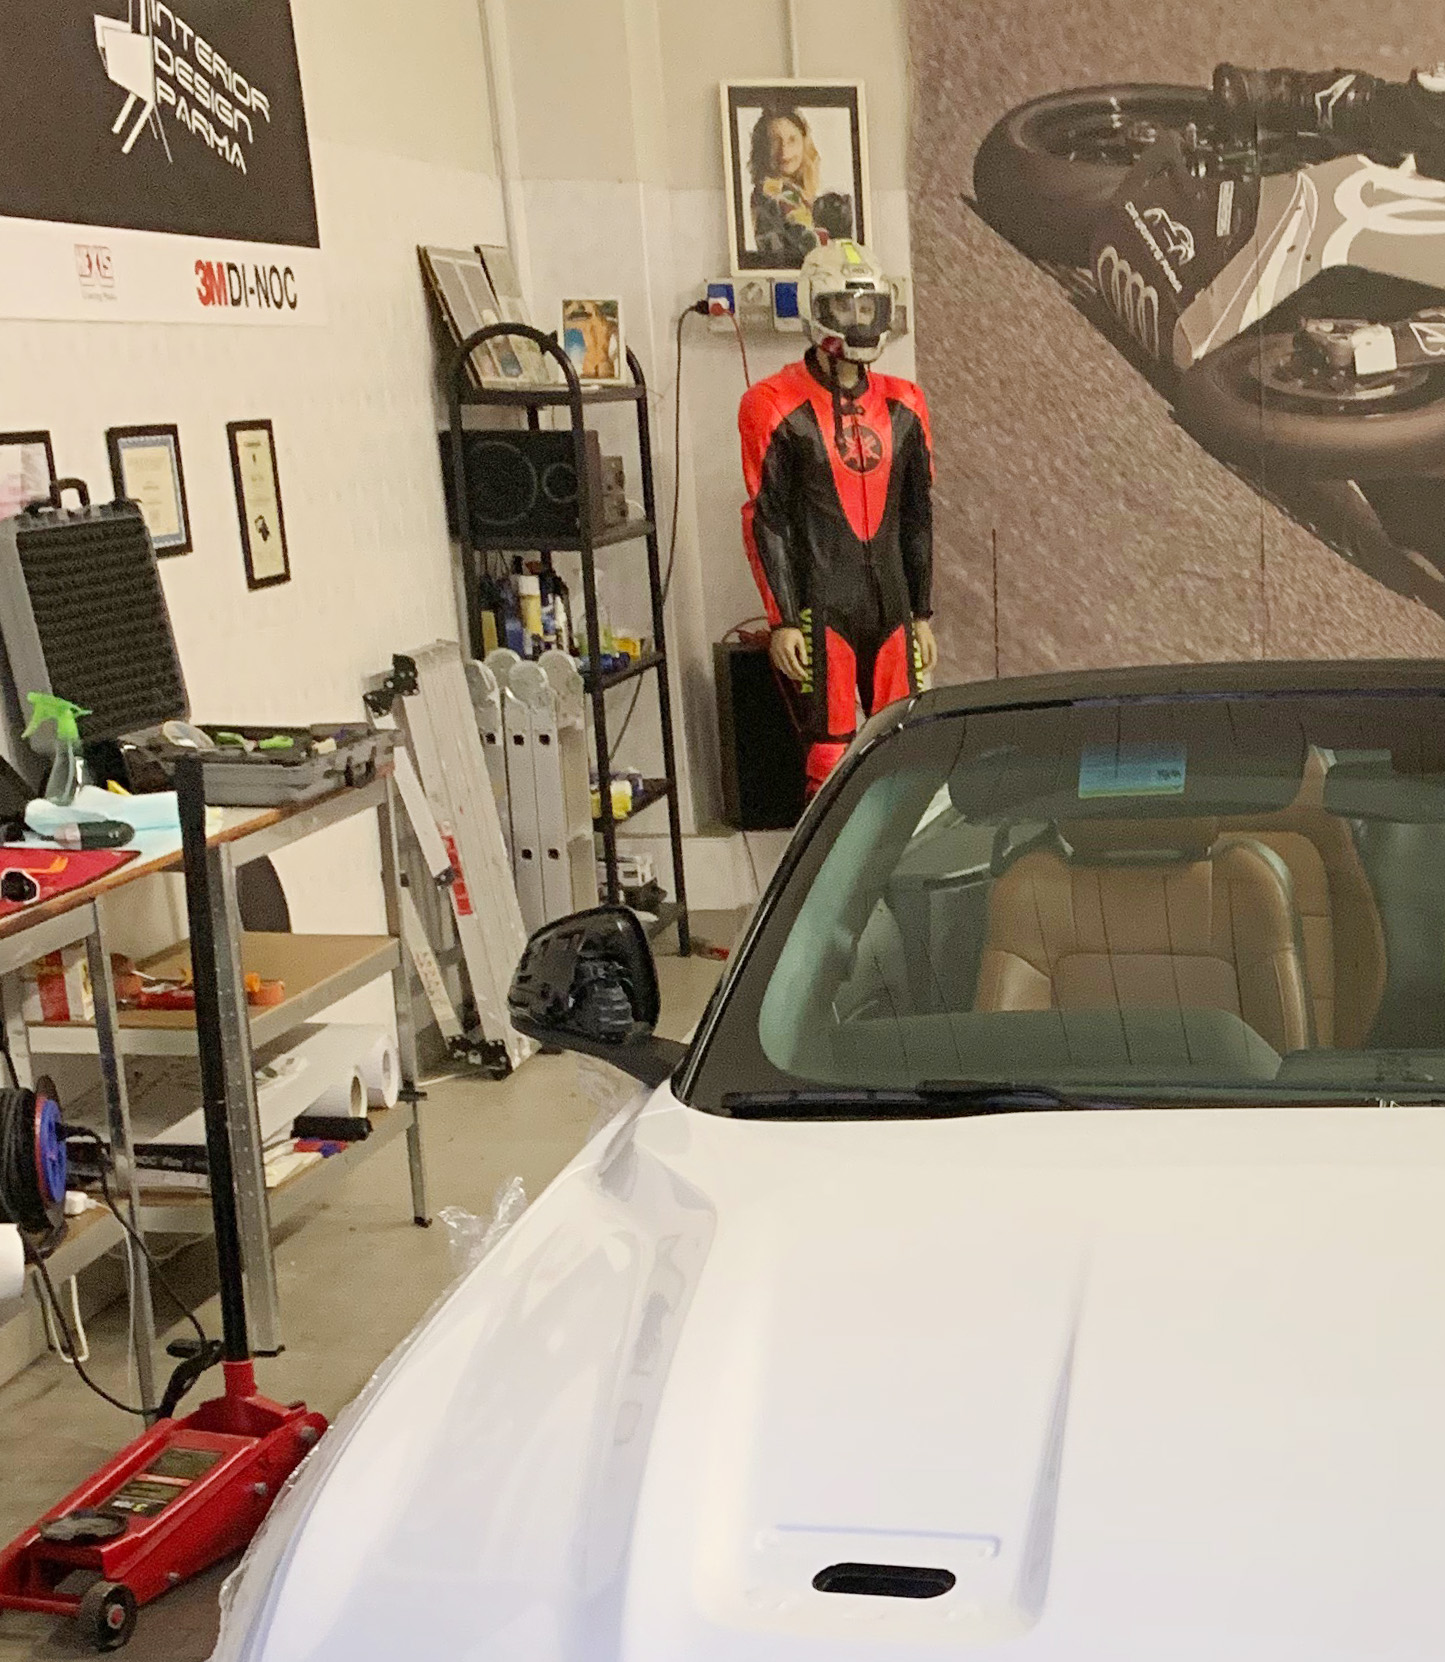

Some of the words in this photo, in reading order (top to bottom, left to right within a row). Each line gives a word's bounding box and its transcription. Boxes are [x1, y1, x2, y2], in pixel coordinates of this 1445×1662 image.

[152, 0, 270, 123] INTERIOR
[154, 36, 254, 144] DESIGN
[156, 76, 247, 175] PARMA
